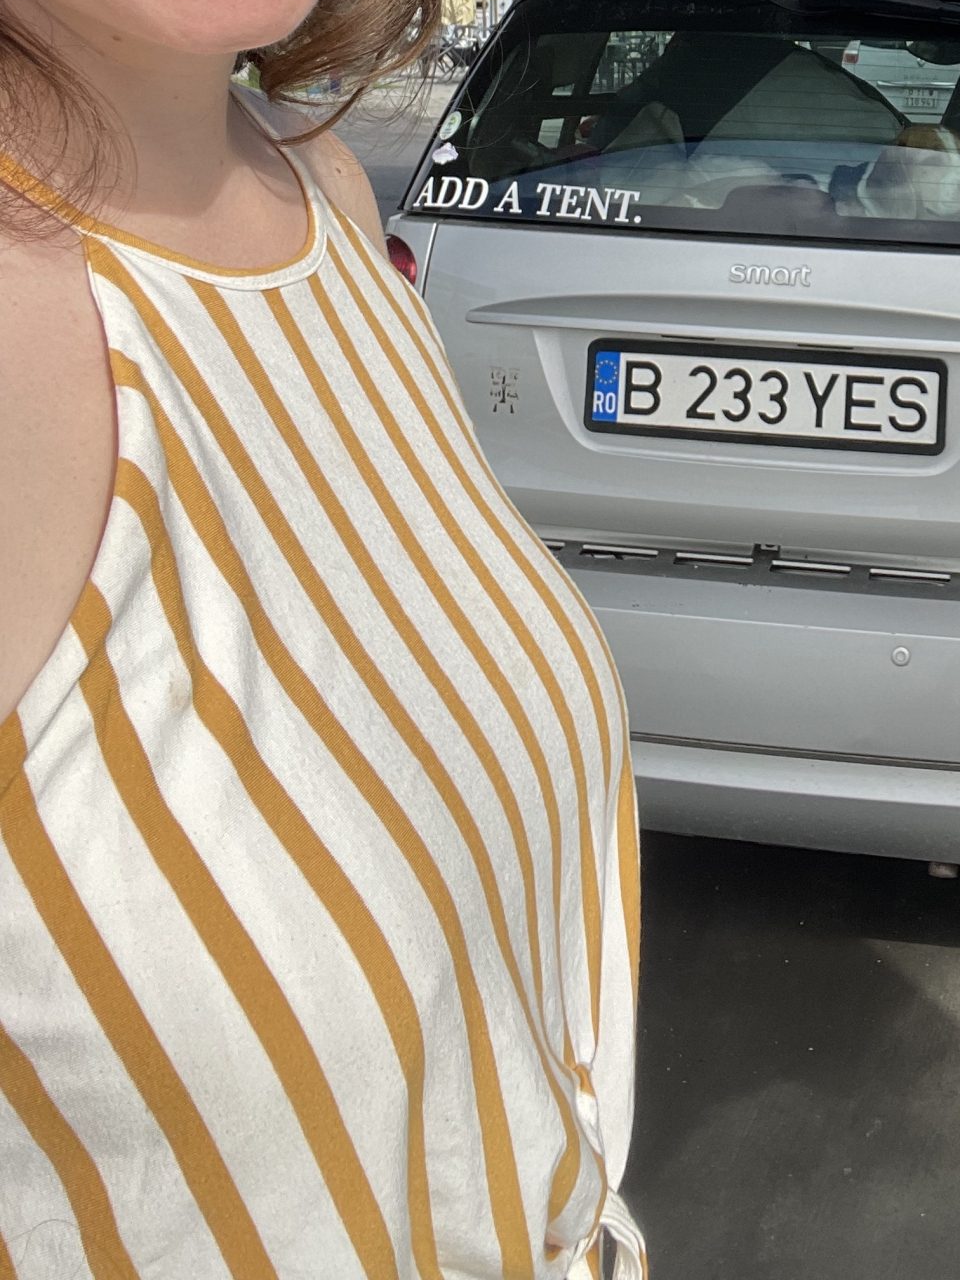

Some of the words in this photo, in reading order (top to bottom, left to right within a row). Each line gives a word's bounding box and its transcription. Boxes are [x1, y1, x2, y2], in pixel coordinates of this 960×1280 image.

[413, 176, 490, 211] ADD
[494, 181, 523, 214] A
[535, 182, 642, 224] TENT.
[729, 264, 811, 288] smart
[593, 391, 615, 414] RO
[624, 360, 661, 415] B
[686, 365, 789, 425] 233
[803, 371, 929, 433] YES
